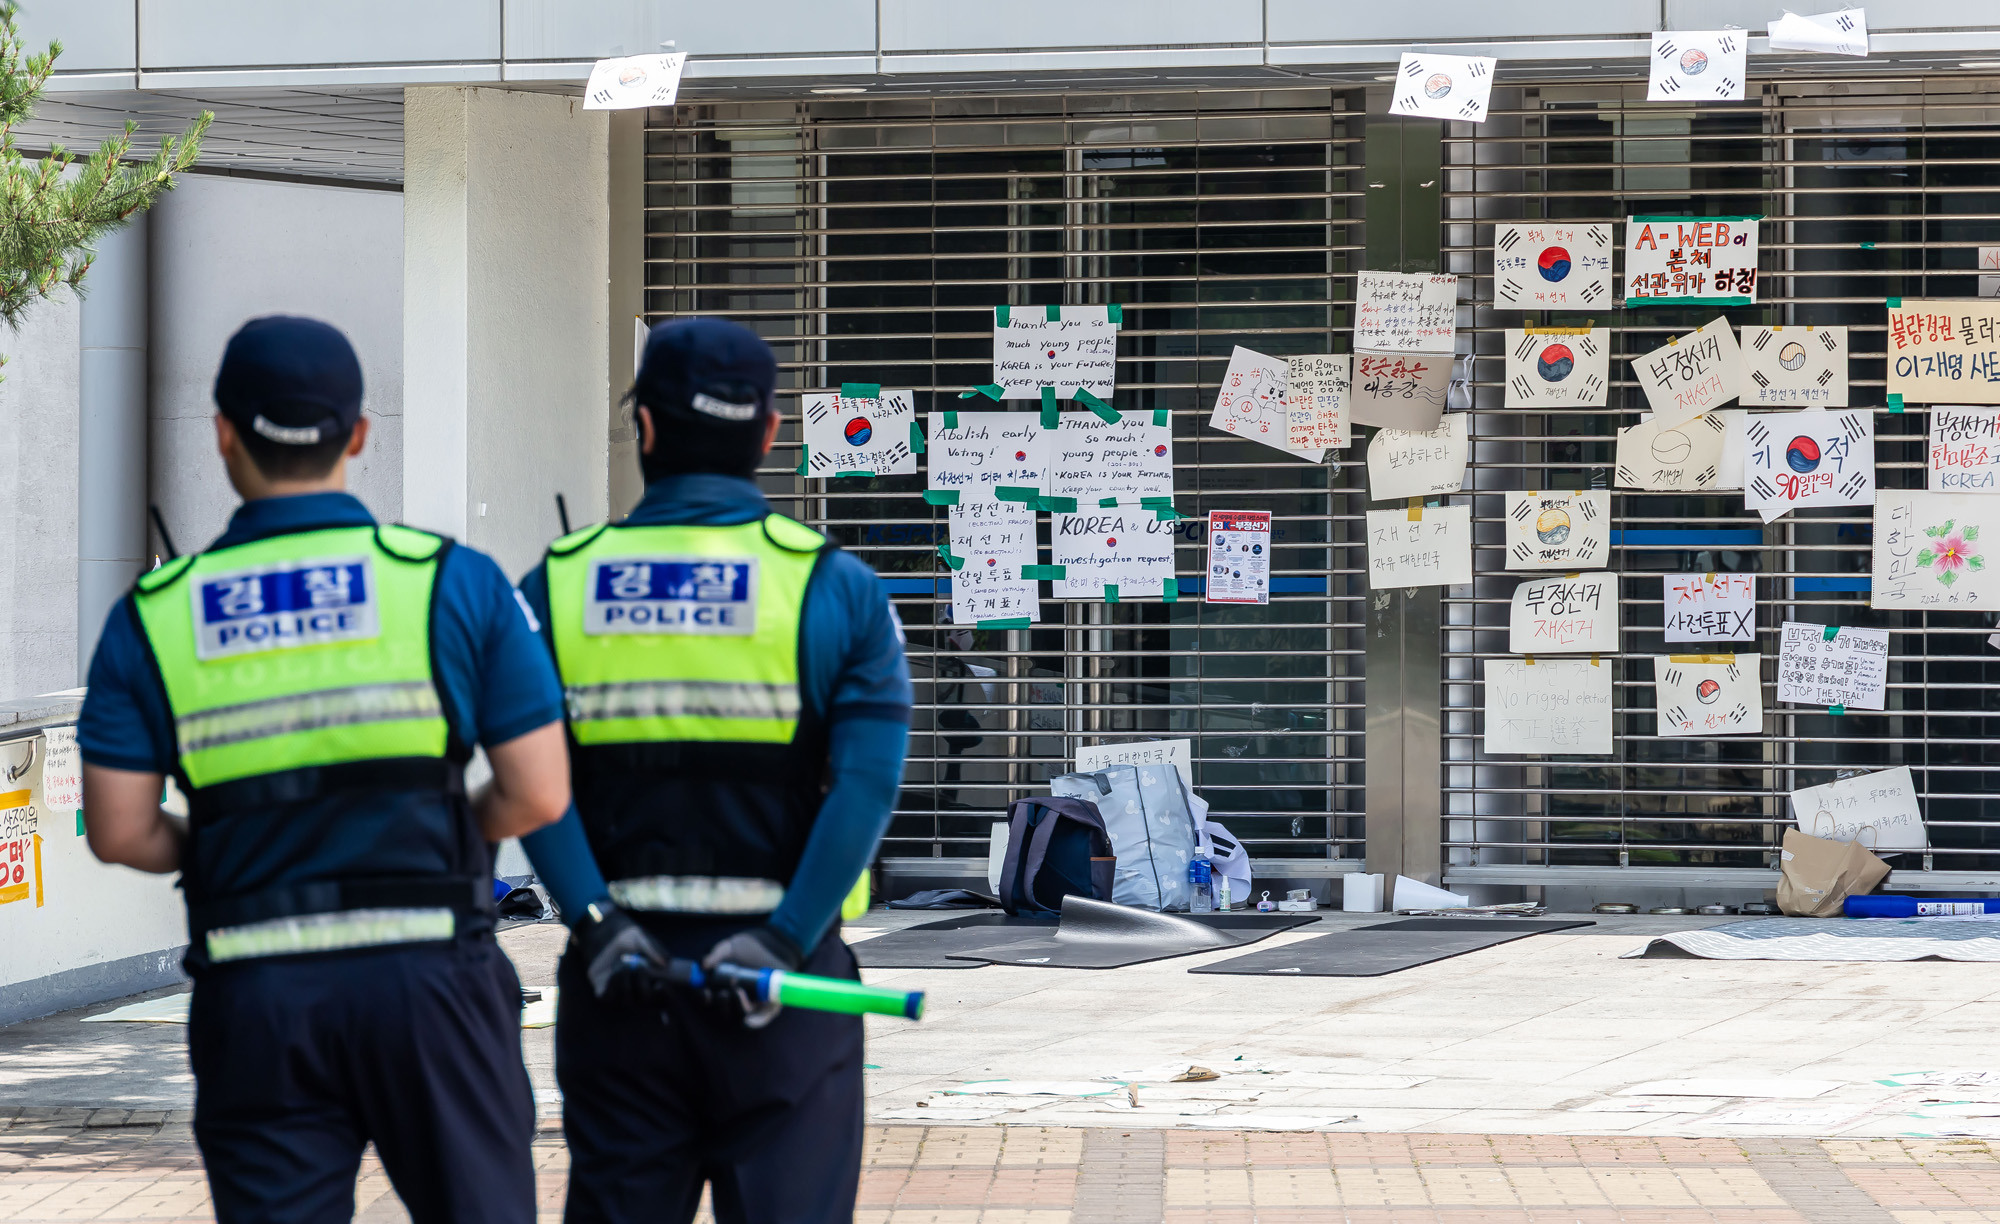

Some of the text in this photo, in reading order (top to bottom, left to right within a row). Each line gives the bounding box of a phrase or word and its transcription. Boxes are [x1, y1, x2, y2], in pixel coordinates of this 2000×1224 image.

[1582, 255, 1609, 271] 수개표
[1666, 249, 1712, 273] 본체
[1631, 268, 1757, 298] 선관위가 하청
[1060, 319, 1081, 331] you
[1891, 313, 1955, 350] 불량정권
[1005, 339, 1070, 352] much young
[1051, 361, 1074, 370] your
[1650, 334, 1722, 390] 부정선거
[1896, 351, 1963, 381] 이재명
[1036, 379, 1096, 391] your country
[1290, 380, 1314, 395] 계엄은
[1364, 376, 1418, 400] 대동강
[1545, 387, 1568, 399] 재선거
[1674, 374, 1725, 410] 재선거
[1288, 395, 1340, 410] 내란은 민주당
[1759, 388, 1830, 402] 부정선거 재선거
[872, 409, 892, 419] 나라
[1289, 411, 1312, 423] 선관위
[1002, 425, 1037, 442] early
[1291, 420, 1338, 437] 이재명 탄핵
[1934, 412, 1995, 442] 부정선거
[1290, 436, 1343, 449] 재판 받아라
[1062, 450, 1094, 462] young
[1932, 443, 1989, 470] 한미공조
[1059, 470, 1093, 480] KOREA
[1652, 468, 1684, 486] 재선거
[1941, 471, 1994, 489] KOREA
[1085, 485, 1103, 495] your
[1109, 484, 1139, 494] country
[1775, 472, 1834, 501] 90일간의
[1223, 521, 1269, 531] K-부정선거
[1539, 548, 1570, 560] 재선거
[1881, 501, 1923, 601] 대한민국
[1059, 552, 1132, 568] investigation
[1373, 550, 1441, 572] 자유 대한민국
[609, 564, 739, 599] 경찰
[215, 566, 353, 617] 경찰
[1525, 583, 1602, 616] 부정선거
[605, 605, 735, 625] POLICE
[218, 612, 358, 646] POLICE
[1534, 619, 1594, 644] 재선거
[1497, 685, 1611, 711] No rigged election
[1784, 684, 1812, 697] STOP
[1817, 688, 1833, 697] THE
[1087, 755, 1112, 769] 자유
[1869, 787, 1903, 803] 투명하고
